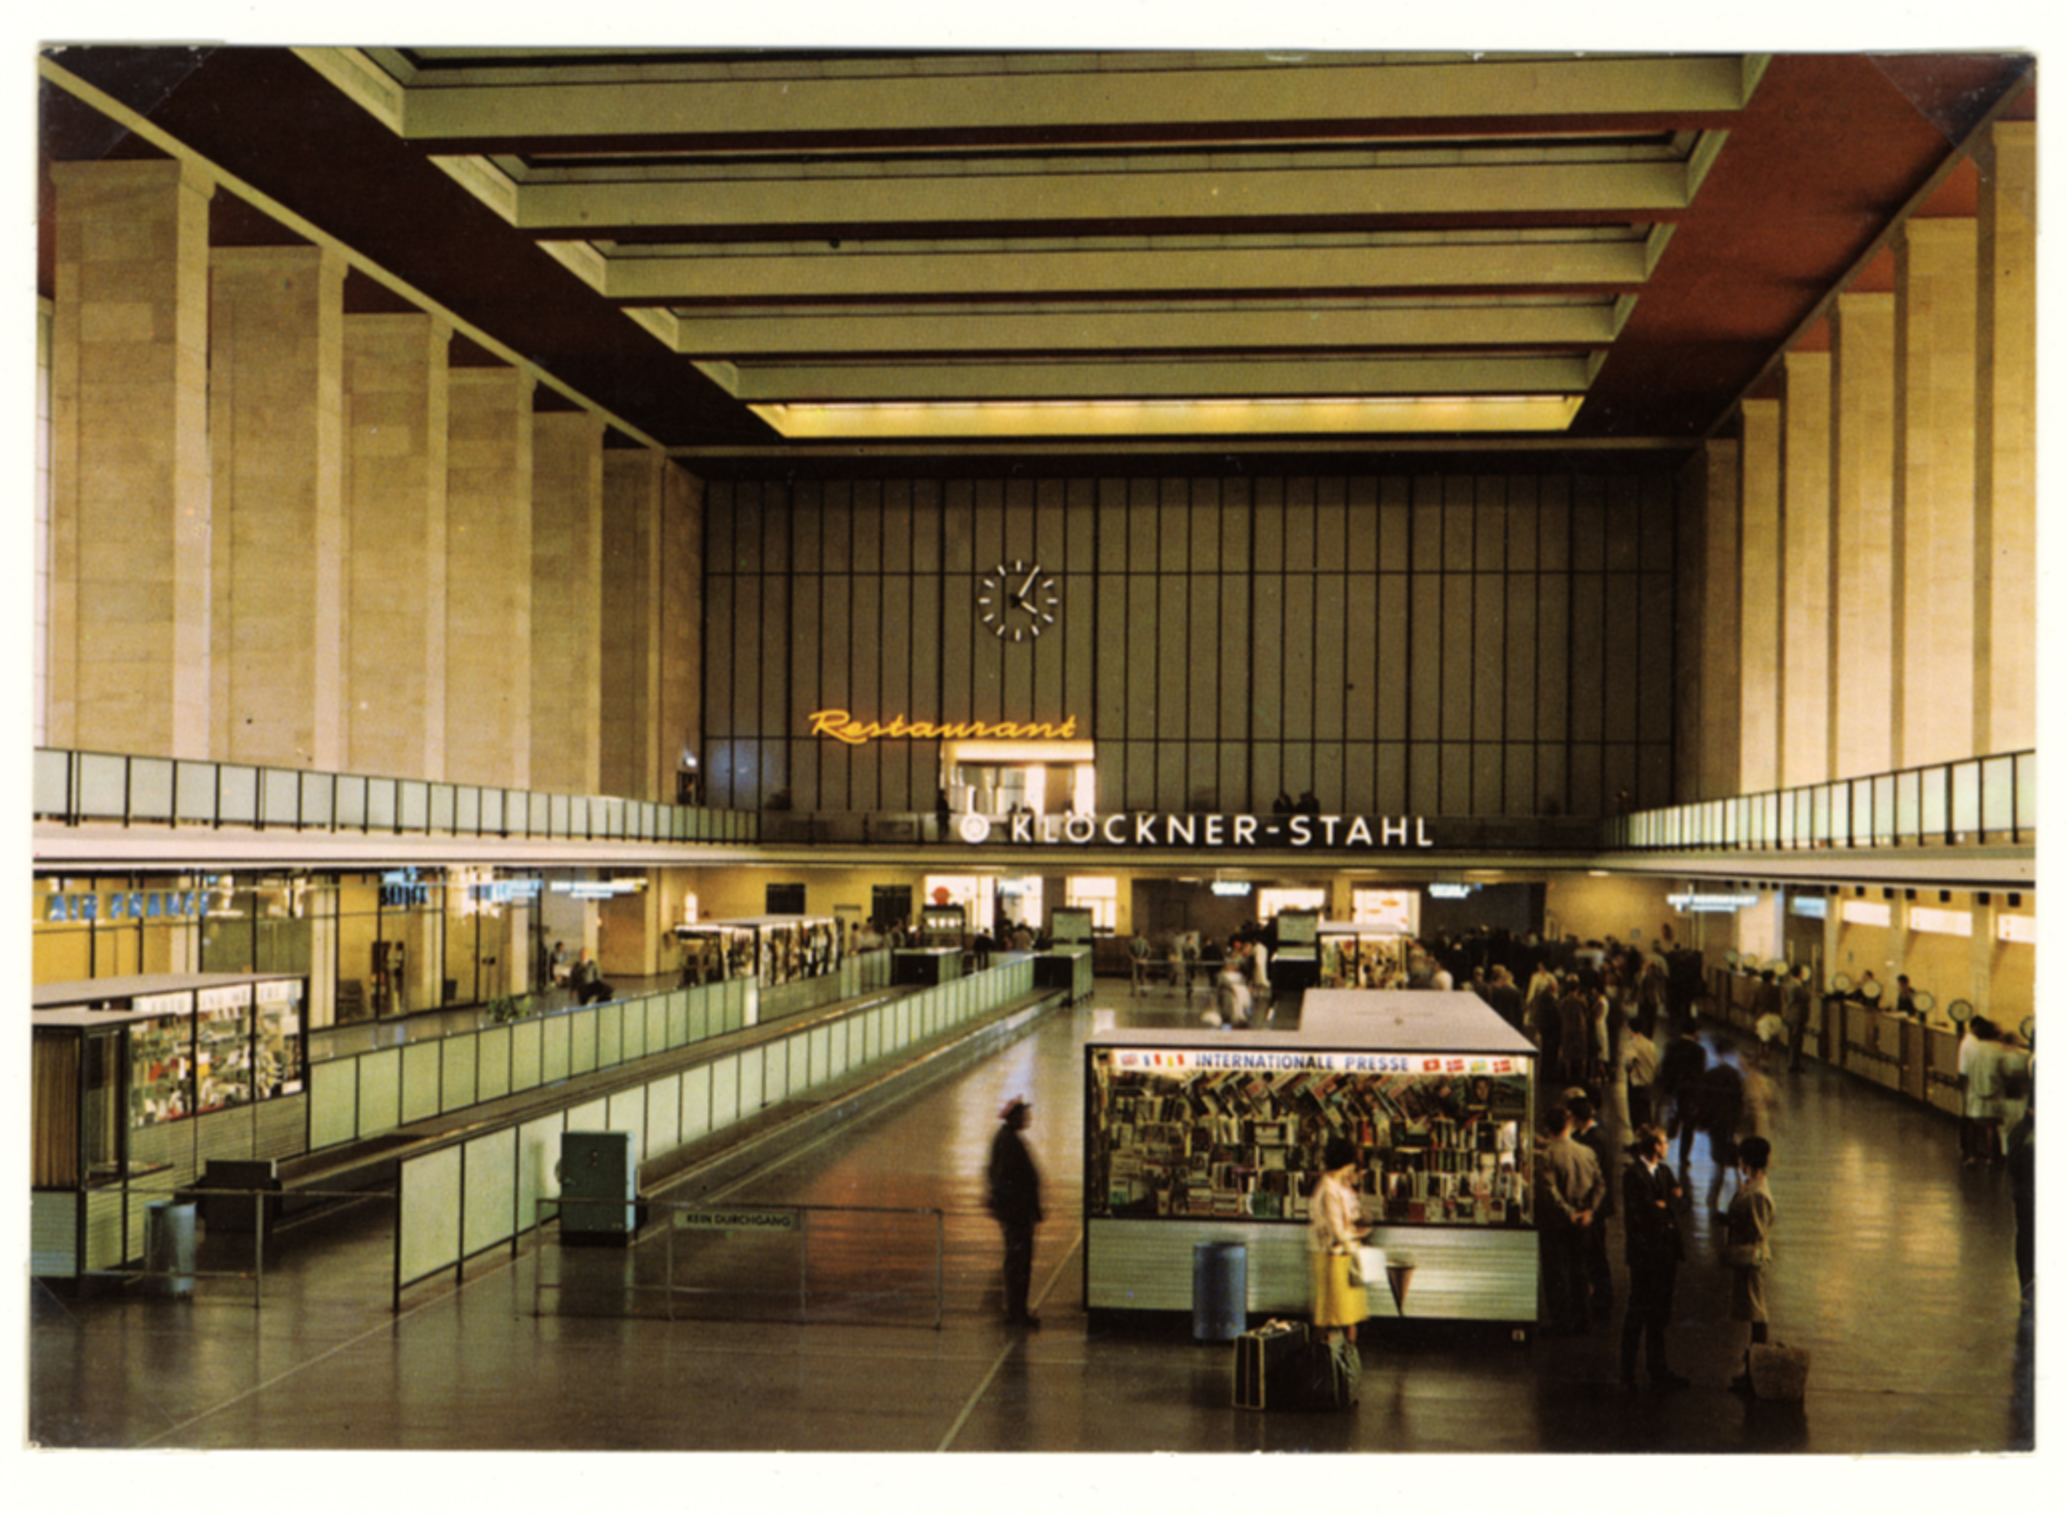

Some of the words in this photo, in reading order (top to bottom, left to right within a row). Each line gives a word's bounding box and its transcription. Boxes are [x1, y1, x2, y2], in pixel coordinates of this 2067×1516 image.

[809, 709, 1077, 744] Restaurant
[1011, 810, 1434, 847] KLÖCKNER-STAHL
[50, 892, 98, 921] AIR
[1195, 1052, 1335, 1071] INTERNATIONALE
[1345, 1055, 1410, 1073] PRESSE
